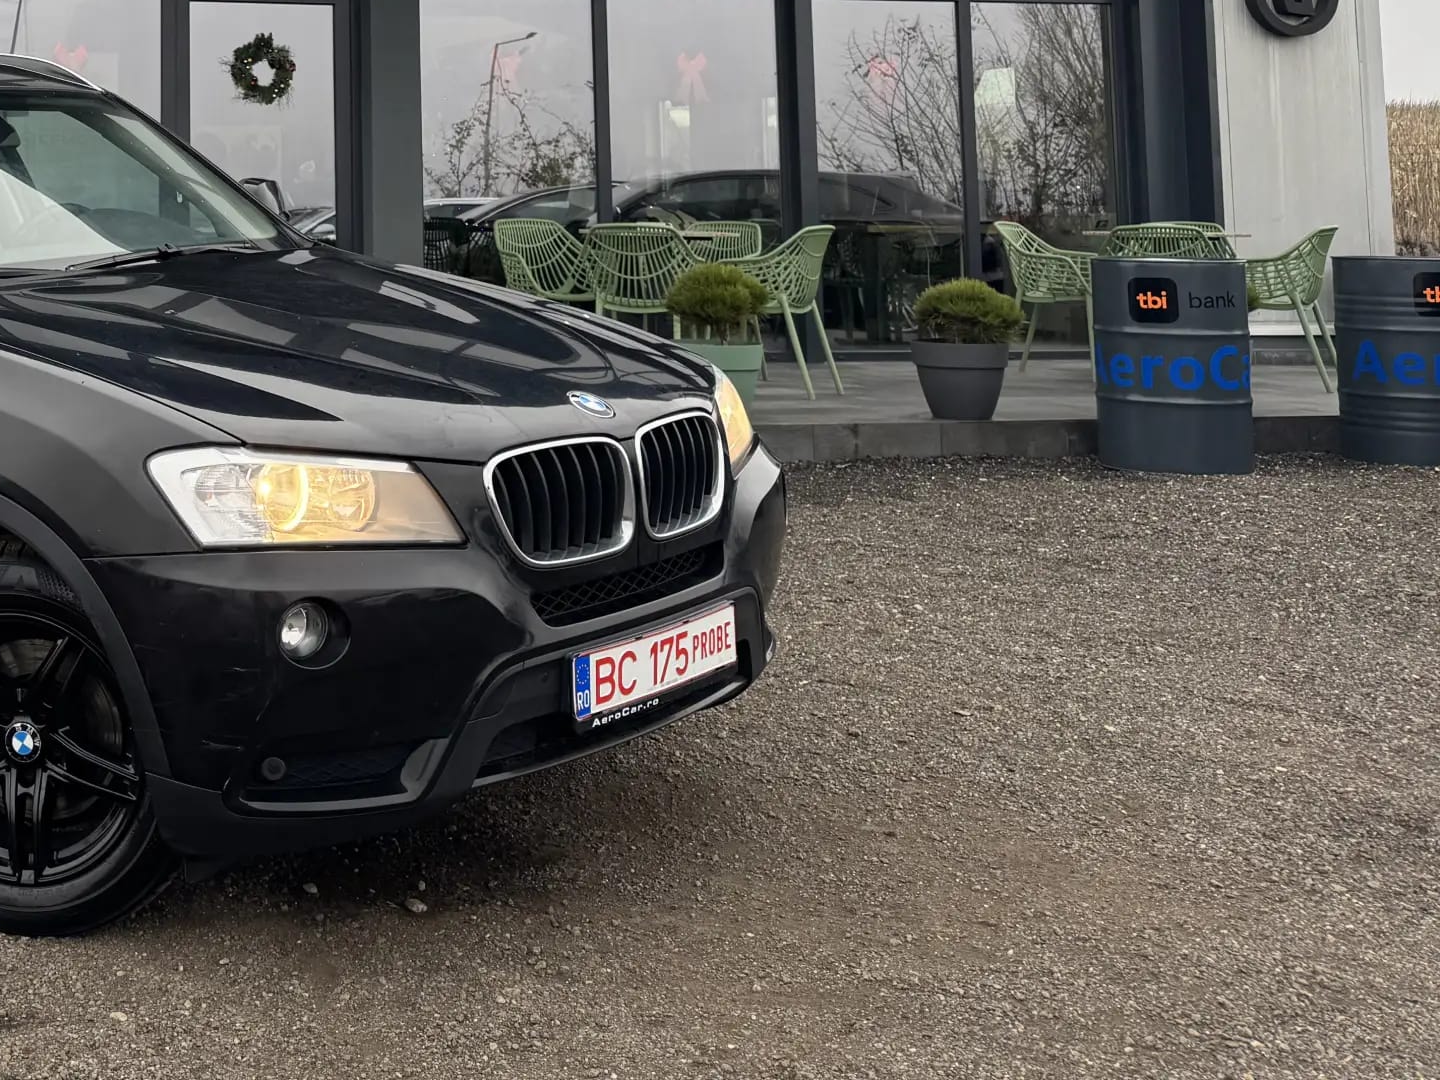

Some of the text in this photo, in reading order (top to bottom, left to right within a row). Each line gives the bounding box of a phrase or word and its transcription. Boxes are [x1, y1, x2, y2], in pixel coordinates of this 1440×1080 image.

[1136, 290, 1236, 309] tbi bank
[595, 621, 731, 706] BC 175 PROBE
[577, 689, 590, 711] RO
[592, 698, 659, 728] AeroCar.ro
